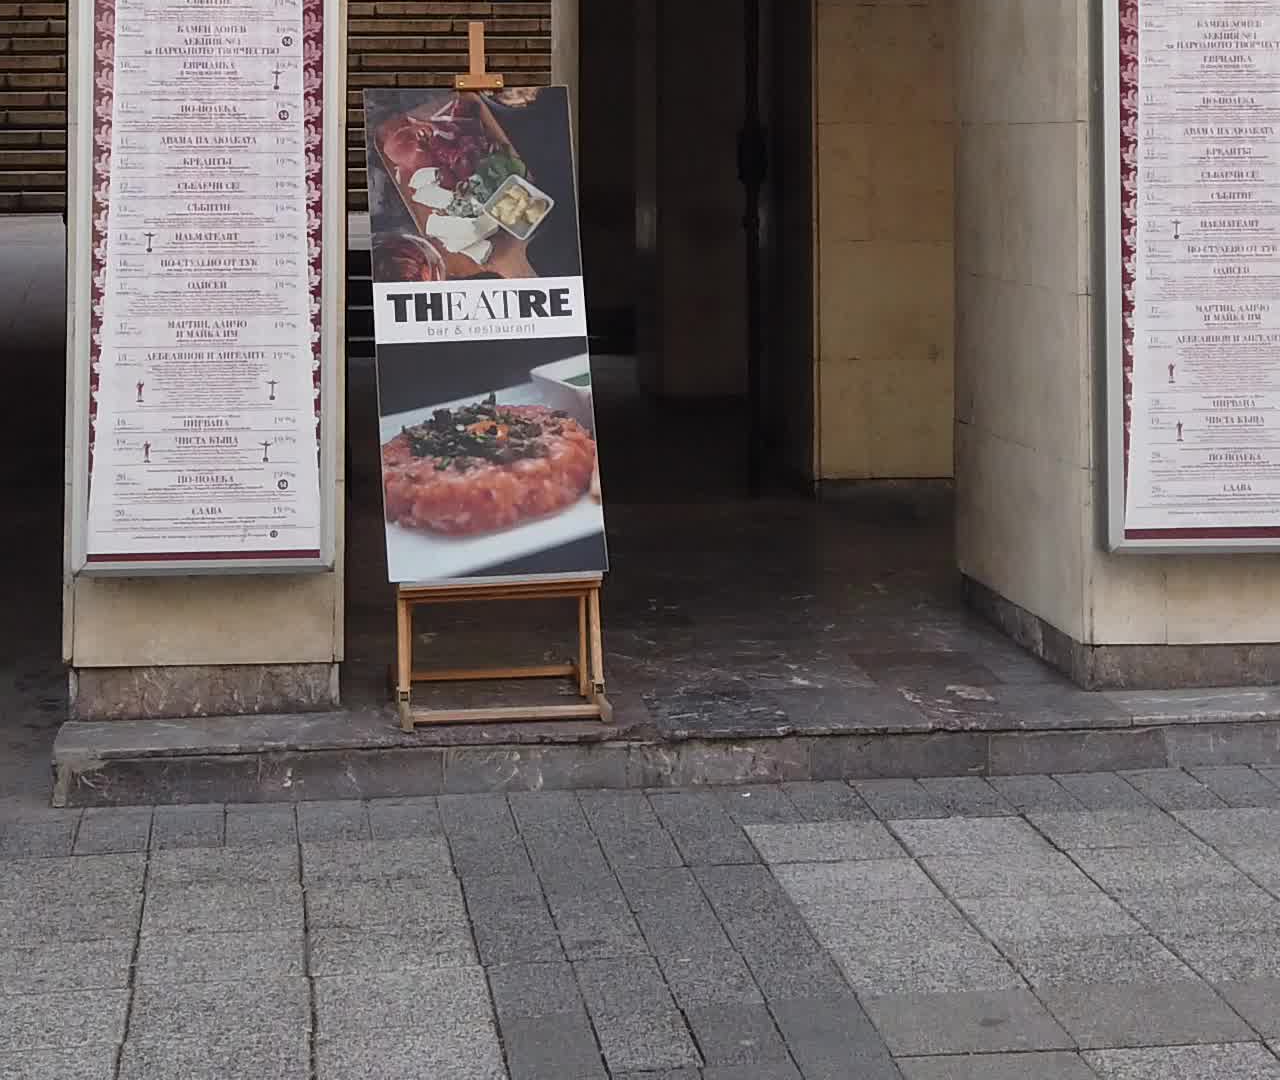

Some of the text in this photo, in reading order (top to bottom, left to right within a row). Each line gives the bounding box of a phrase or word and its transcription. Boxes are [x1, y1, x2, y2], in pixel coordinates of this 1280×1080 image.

[386, 287, 572, 323] THEATRE
[427, 322, 536, 337] bar & restaurant
